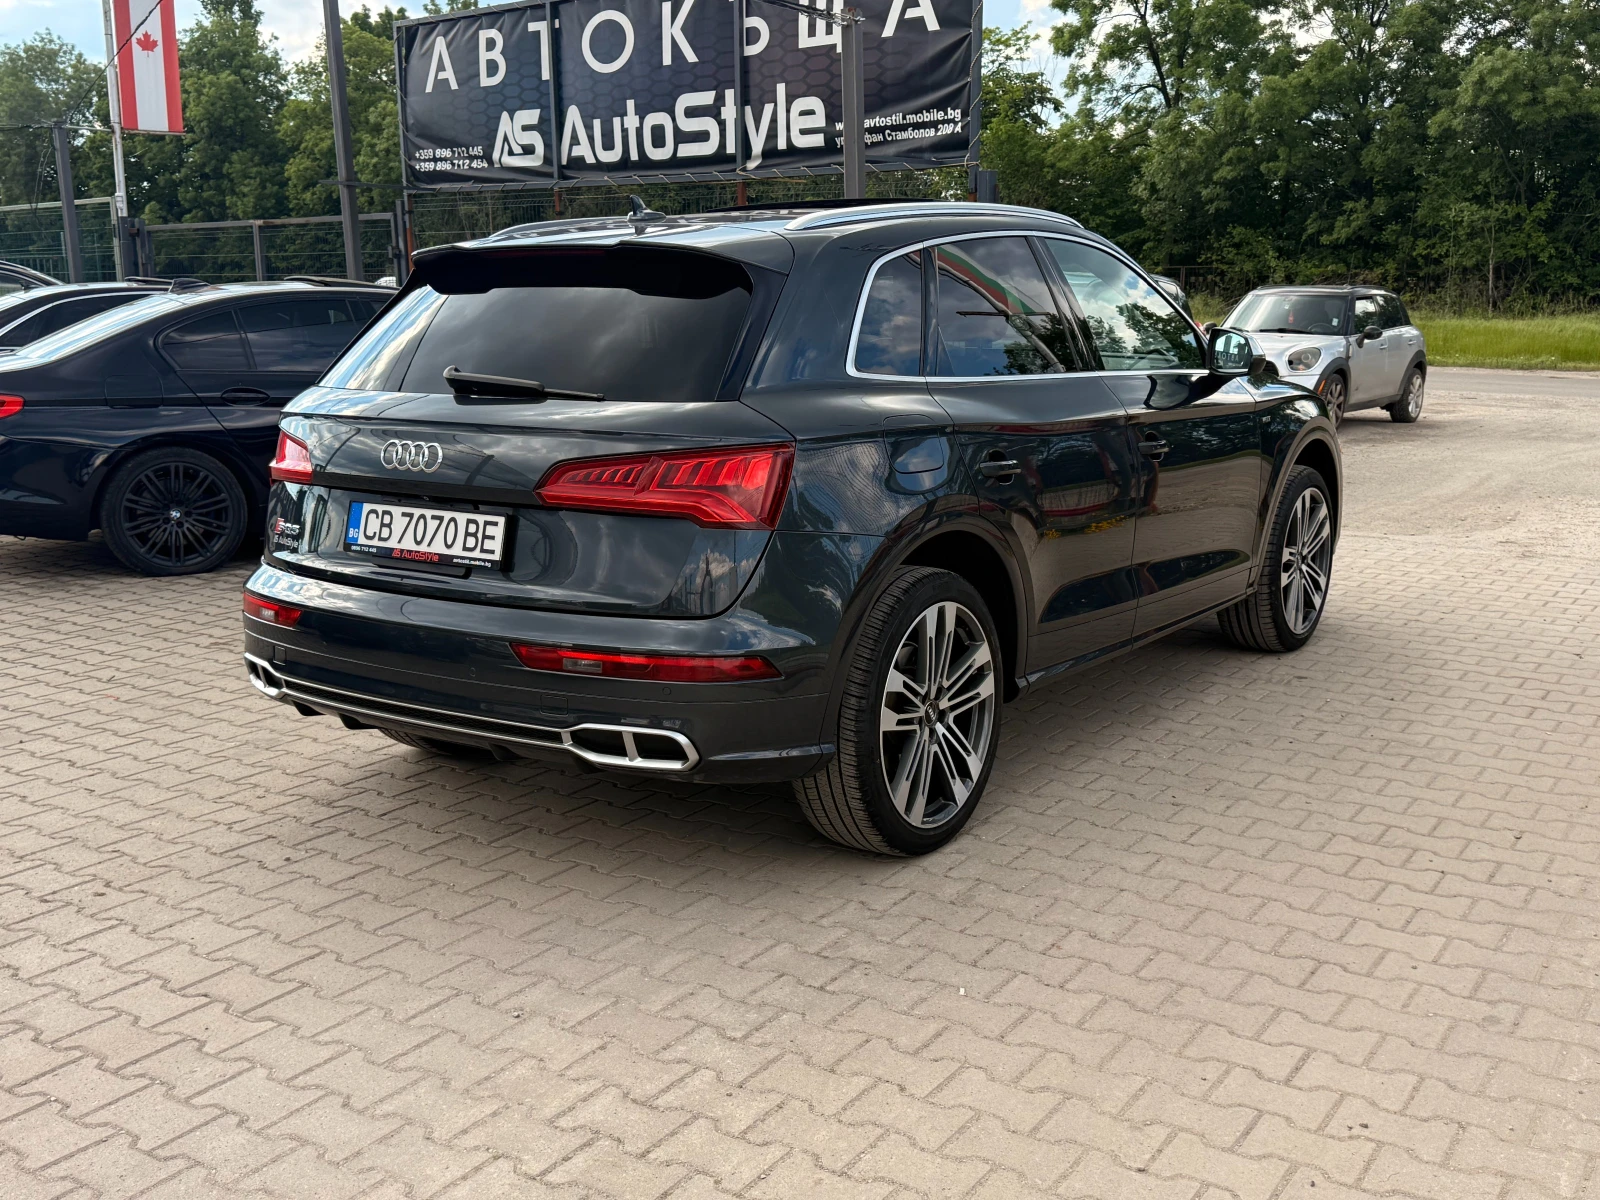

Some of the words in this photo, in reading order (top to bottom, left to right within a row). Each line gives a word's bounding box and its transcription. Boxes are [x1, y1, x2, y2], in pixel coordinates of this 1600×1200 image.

[560, 82, 827, 171] AutoStyle
[835, 107, 962, 131] wavtostil.mobile.bg
[885, 127, 935, 141] Стамболов
[936, 122, 955, 136] 208
[415, 149, 433, 159] +359
[435, 148, 452, 158] 896
[453, 147, 469, 158] 712
[469, 146, 483, 156] 445
[415, 162, 434, 172] +359
[435, 160, 452, 171] 896
[453, 159, 470, 170] 712
[471, 159, 488, 169] 454
[349, 528, 359, 538] BG
[363, 508, 394, 542] CB
[396, 512, 458, 549] 7070
[462, 517, 499, 555] BE
[402, 550, 439, 562] AutoStyle
